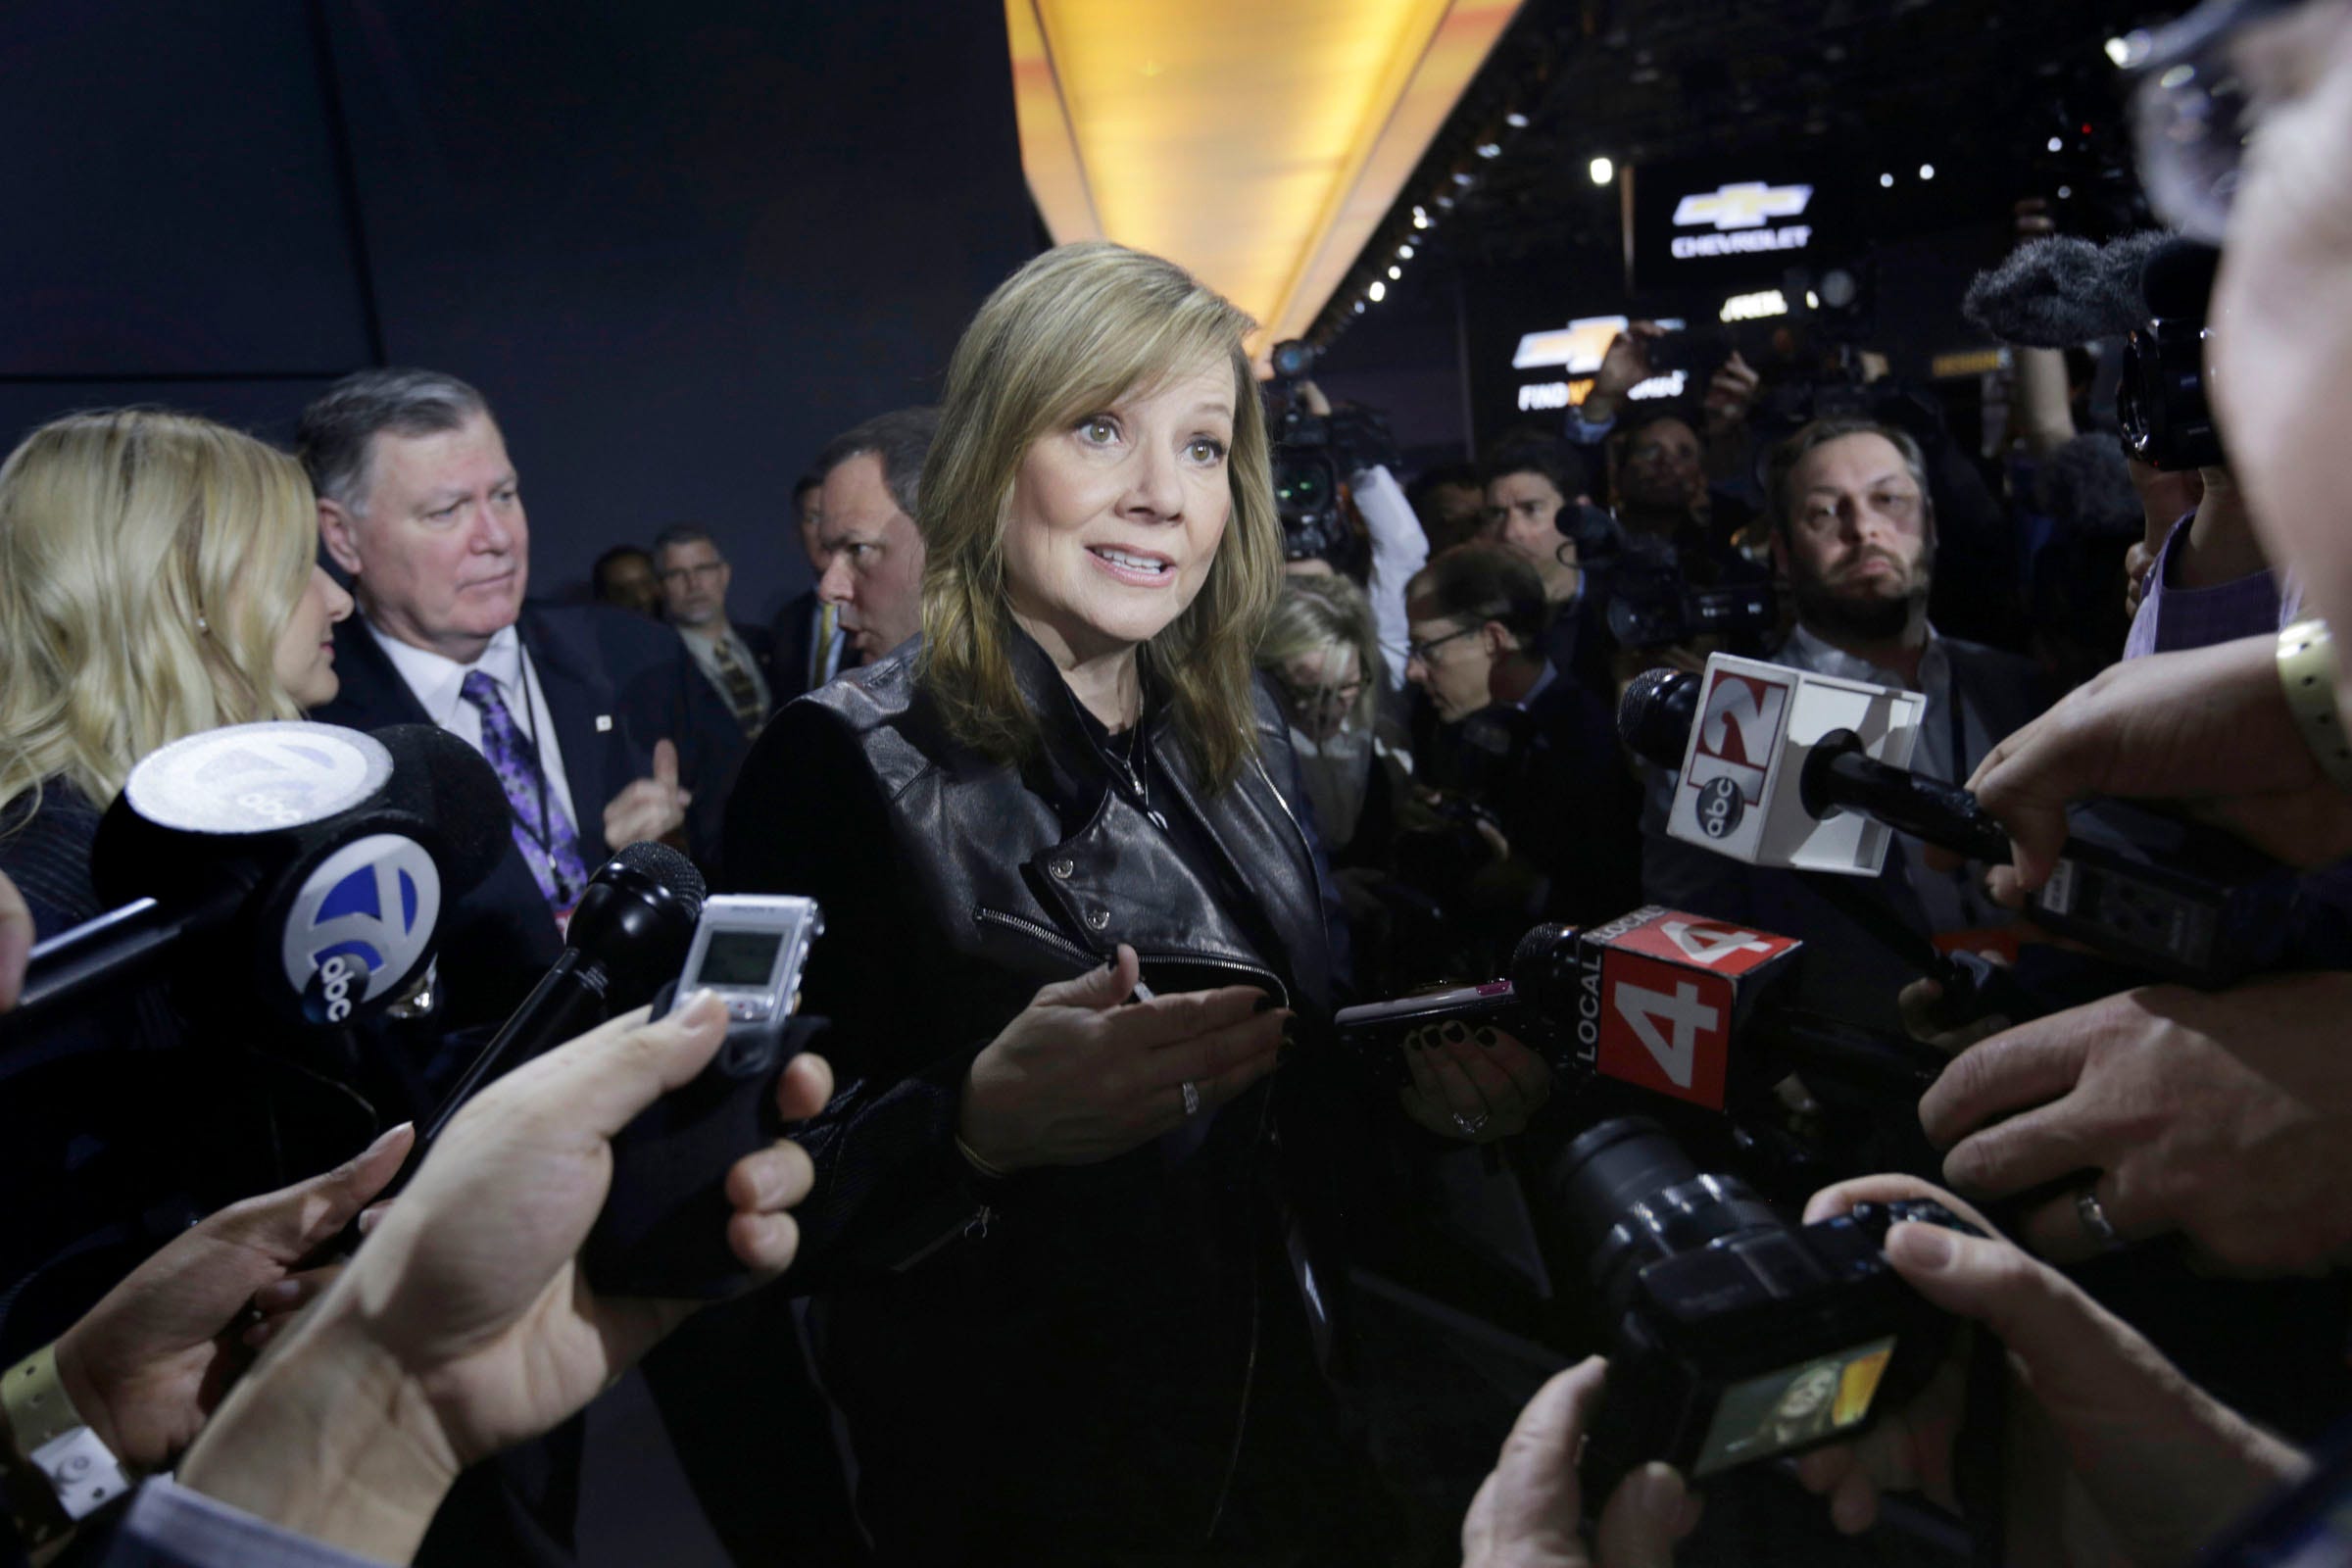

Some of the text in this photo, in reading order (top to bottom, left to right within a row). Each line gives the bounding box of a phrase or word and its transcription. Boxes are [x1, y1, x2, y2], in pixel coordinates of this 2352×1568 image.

[1672, 225, 1810, 259] CHEVROLET
[1705, 777, 1734, 838] abc
[1596, 905, 1666, 943] LOCAL
[1660, 920, 1773, 965] 4
[321, 956, 355, 1022] abc
[1577, 954, 1602, 1063] LOCAL
[1614, 980, 1719, 1090] 4
